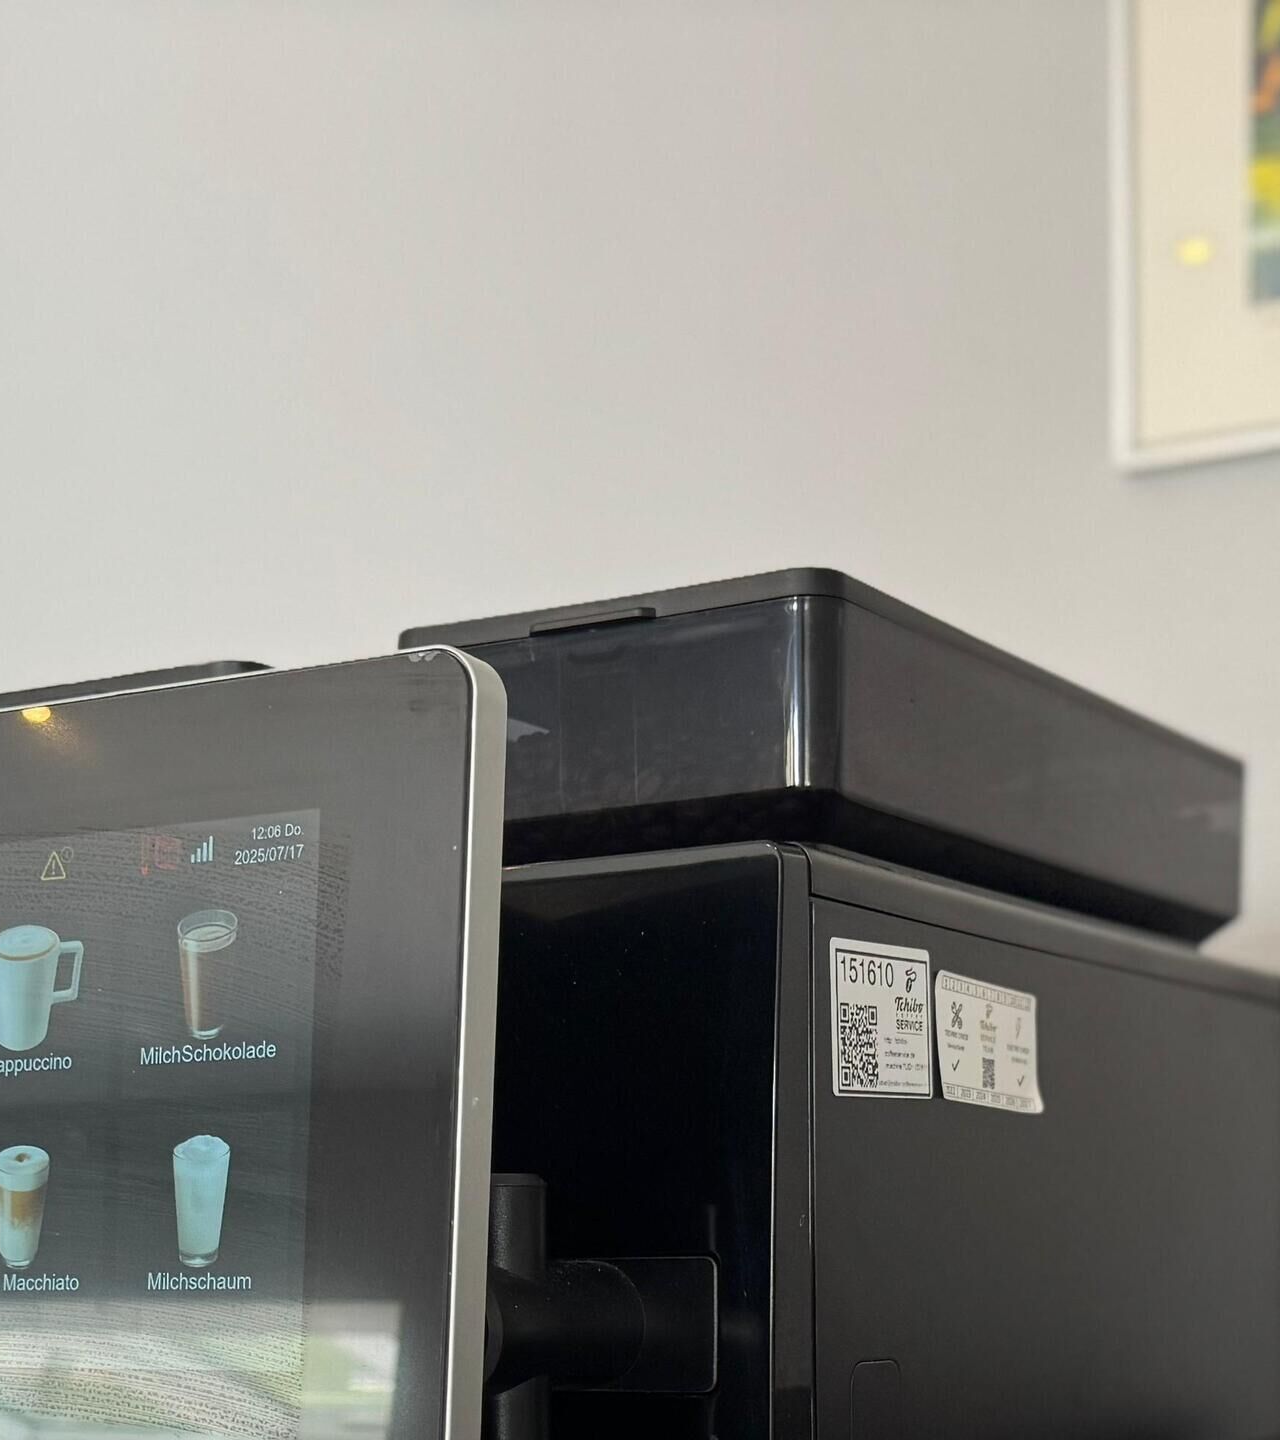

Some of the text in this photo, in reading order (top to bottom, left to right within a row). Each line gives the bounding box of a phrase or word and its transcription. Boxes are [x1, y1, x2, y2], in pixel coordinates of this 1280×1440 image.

[251, 823, 282, 841] 12:06
[234, 843, 305, 865] 2025/07/17
[840, 956, 894, 988] 151610
[895, 996, 924, 1014] Tchibo
[896, 1019, 923, 1032] SERVICE
[140, 1040, 277, 1065] MilchSchokolade
[3, 1273, 80, 1291] Macchiato
[147, 1272, 252, 1290] Milchschaum
